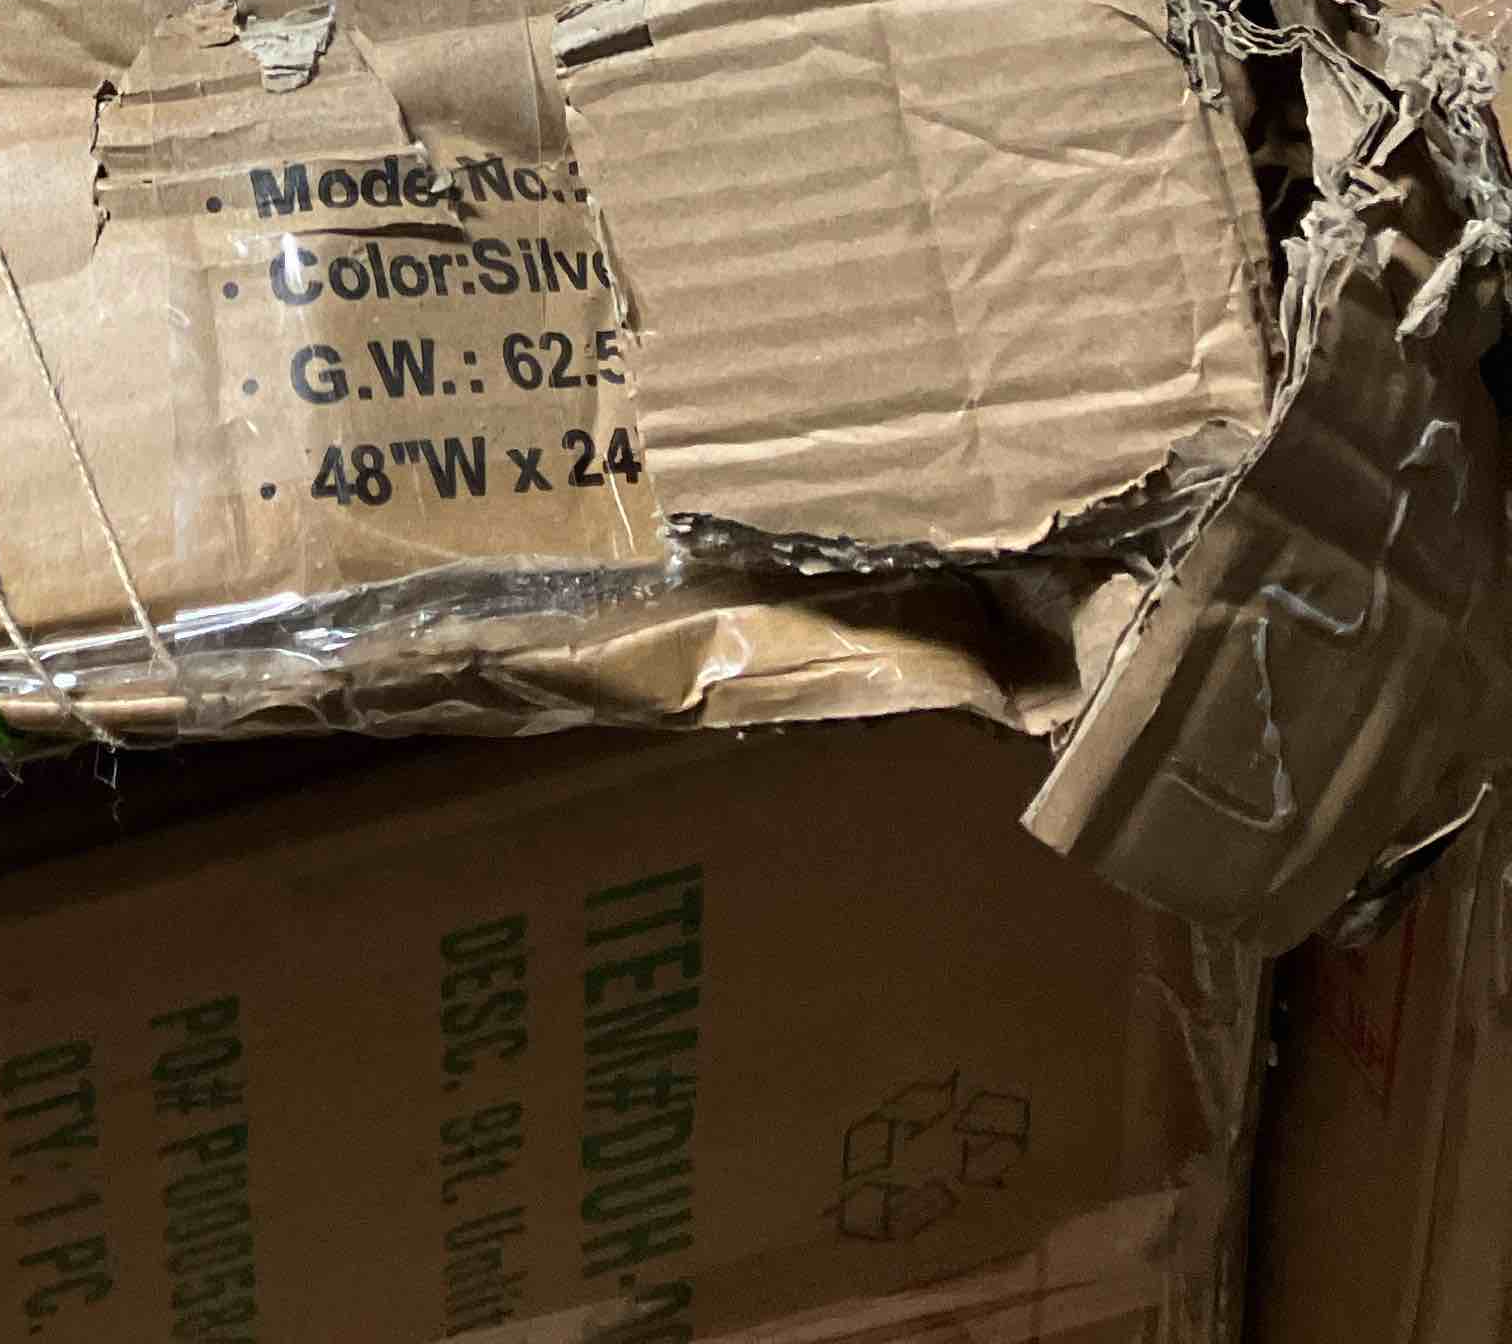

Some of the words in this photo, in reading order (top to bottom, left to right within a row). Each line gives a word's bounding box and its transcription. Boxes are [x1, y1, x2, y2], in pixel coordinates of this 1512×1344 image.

[250, 156, 464, 218] Mode
[290, 338, 484, 405] G.W.:
[502, 330, 626, 390] 62.5
[311, 436, 486, 505] 48"W
[506, 448, 552, 493] x
